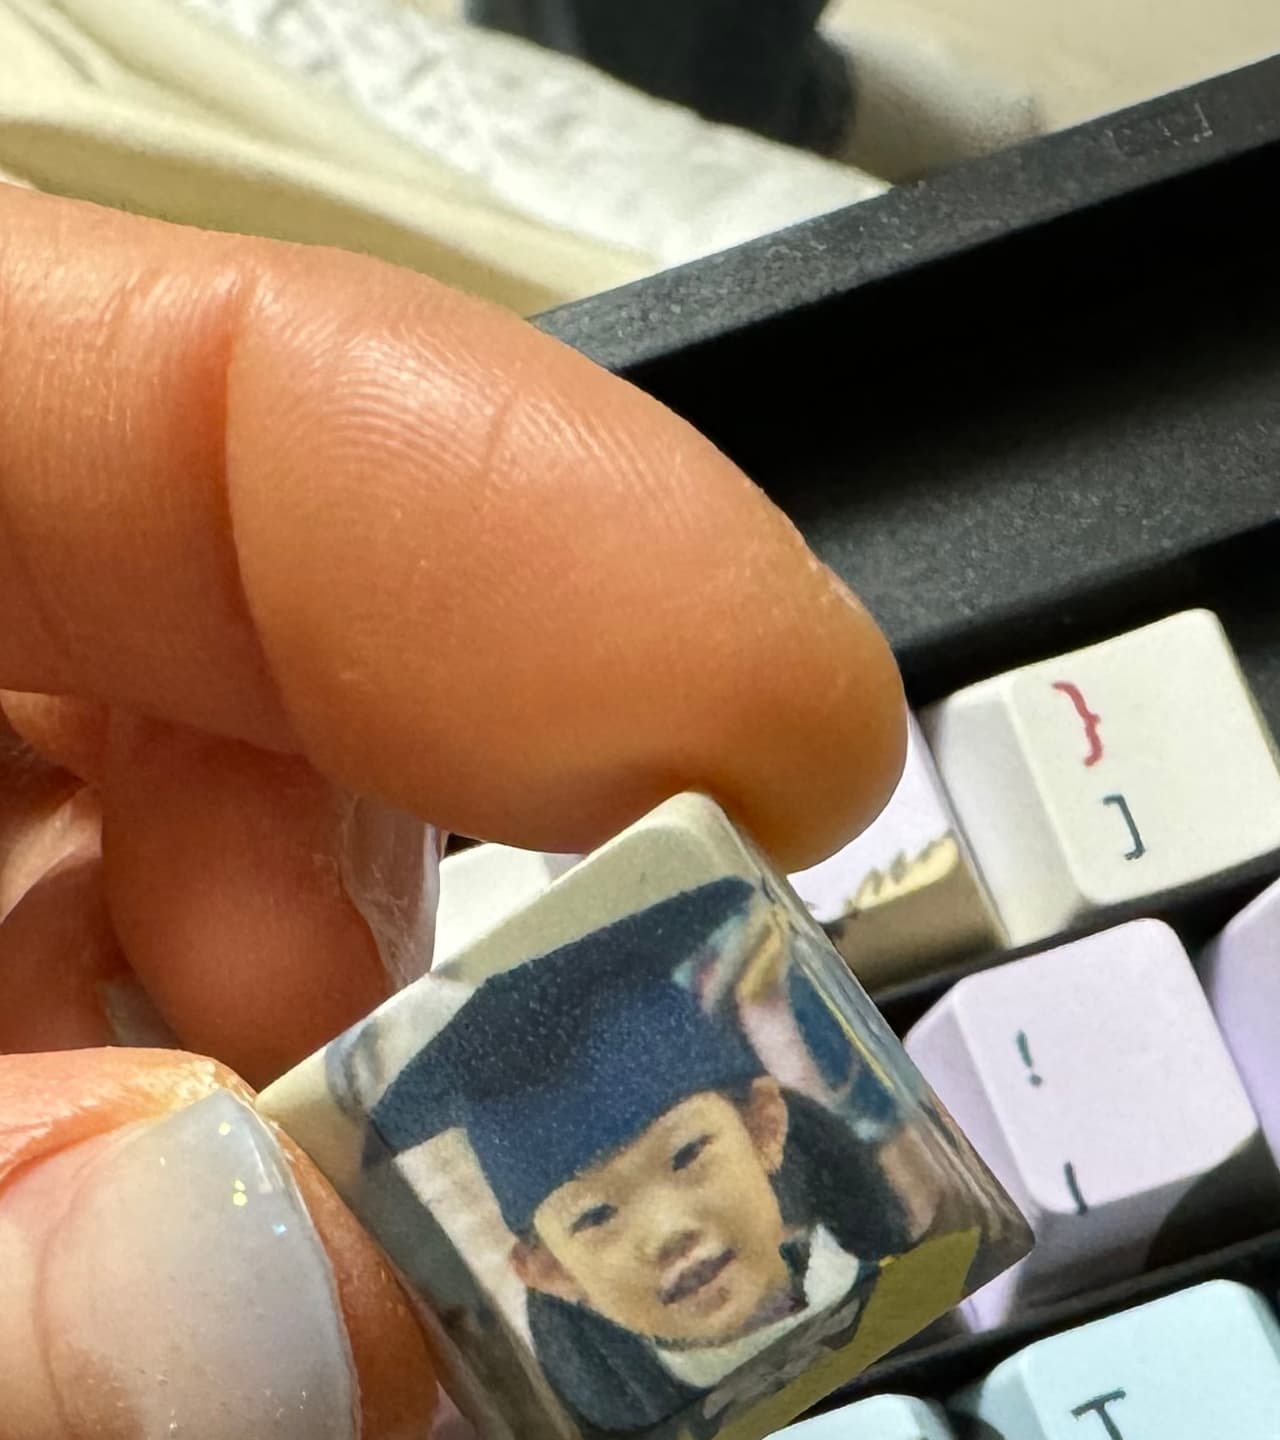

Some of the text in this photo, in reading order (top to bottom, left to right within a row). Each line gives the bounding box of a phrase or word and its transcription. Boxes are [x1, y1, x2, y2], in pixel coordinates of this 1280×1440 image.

[1051, 681, 1104, 768] }
[1102, 794, 1146, 861] ]
[1015, 1030, 1043, 1087] !
